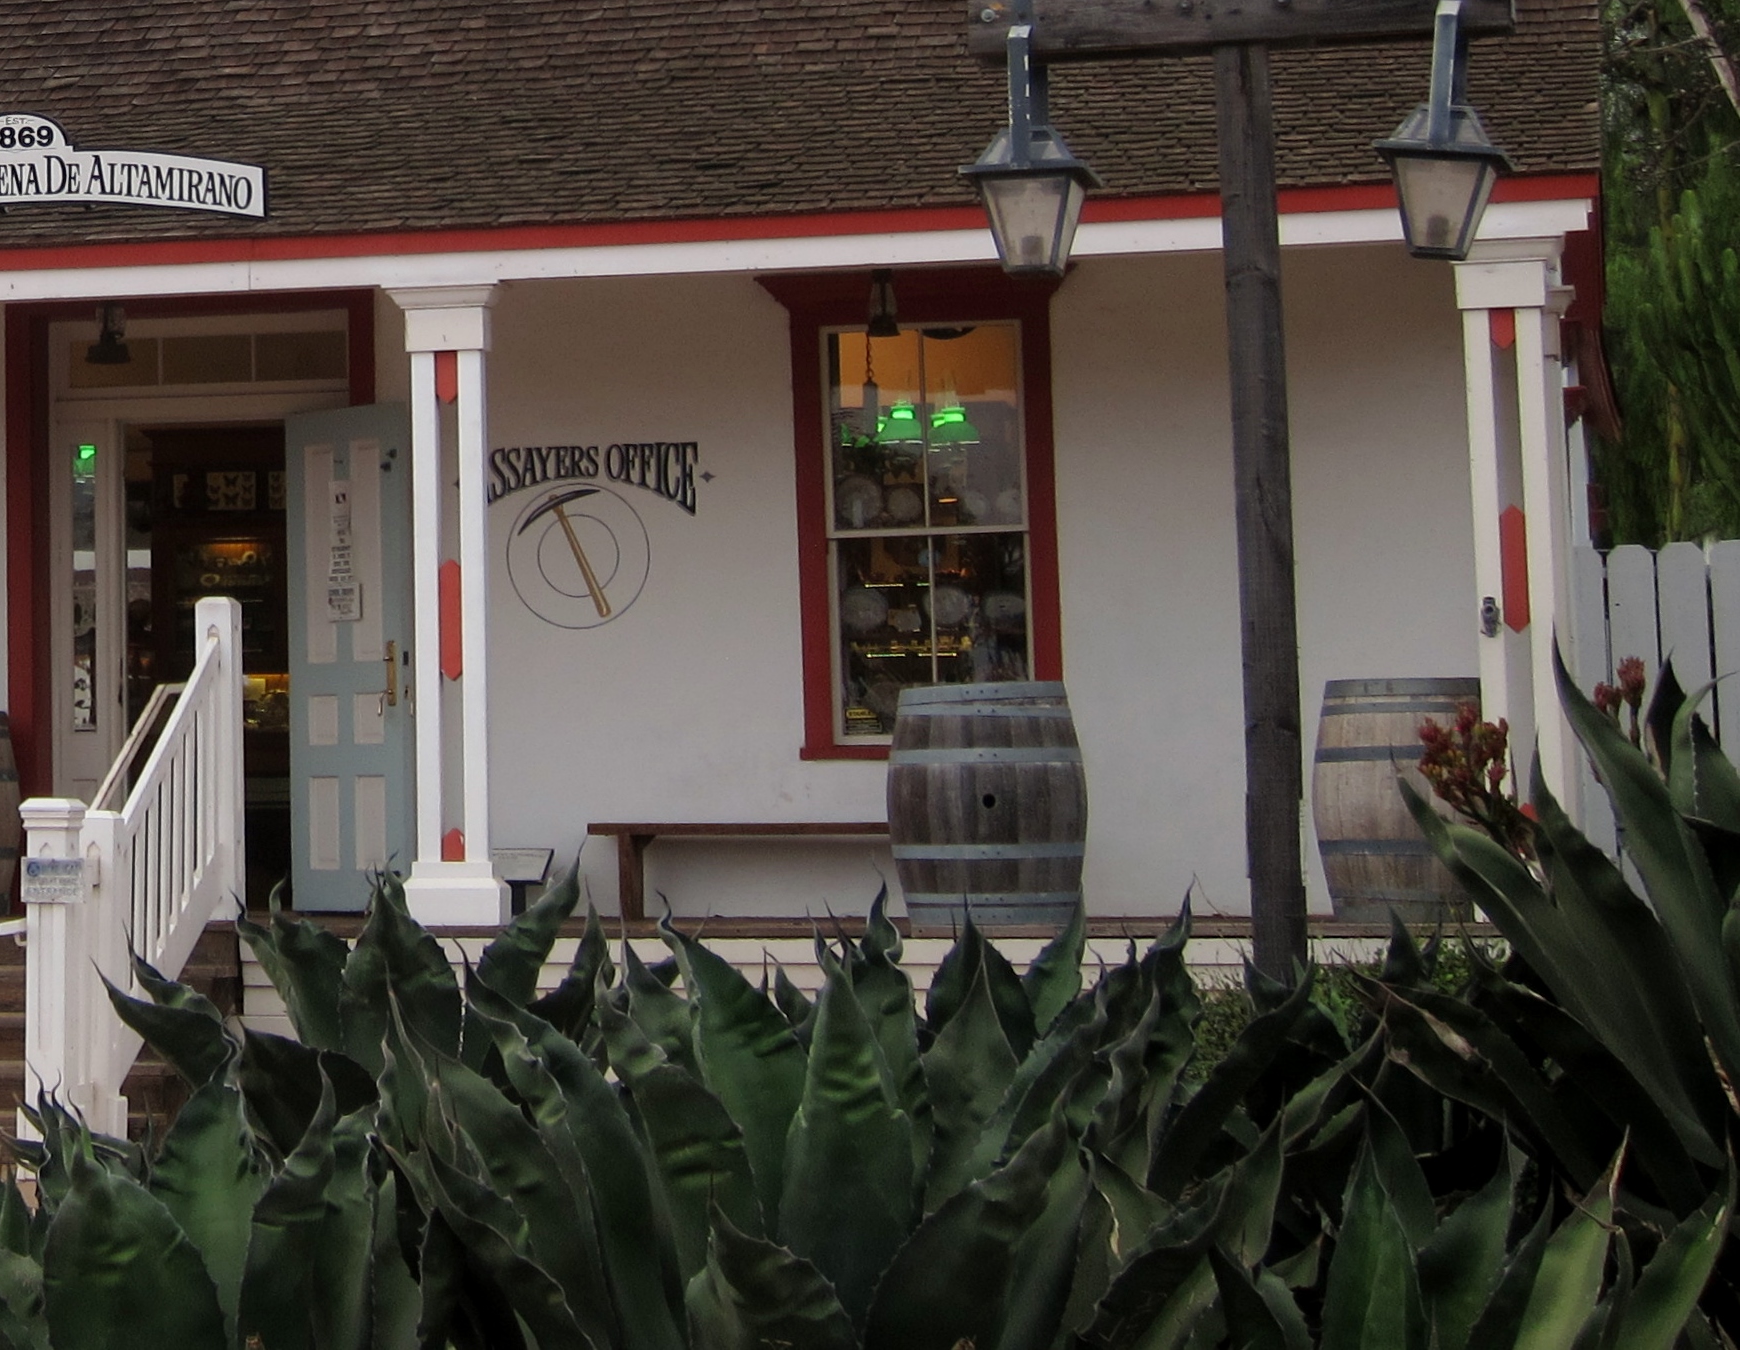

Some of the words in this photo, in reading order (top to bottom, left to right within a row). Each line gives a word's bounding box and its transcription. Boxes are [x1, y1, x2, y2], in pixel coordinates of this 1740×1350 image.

[43, 154, 80, 195] DE
[84, 154, 253, 210] ALTAMIRANO
[487, 445, 600, 505] SSAYERS
[605, 441, 698, 516] OFFICE
